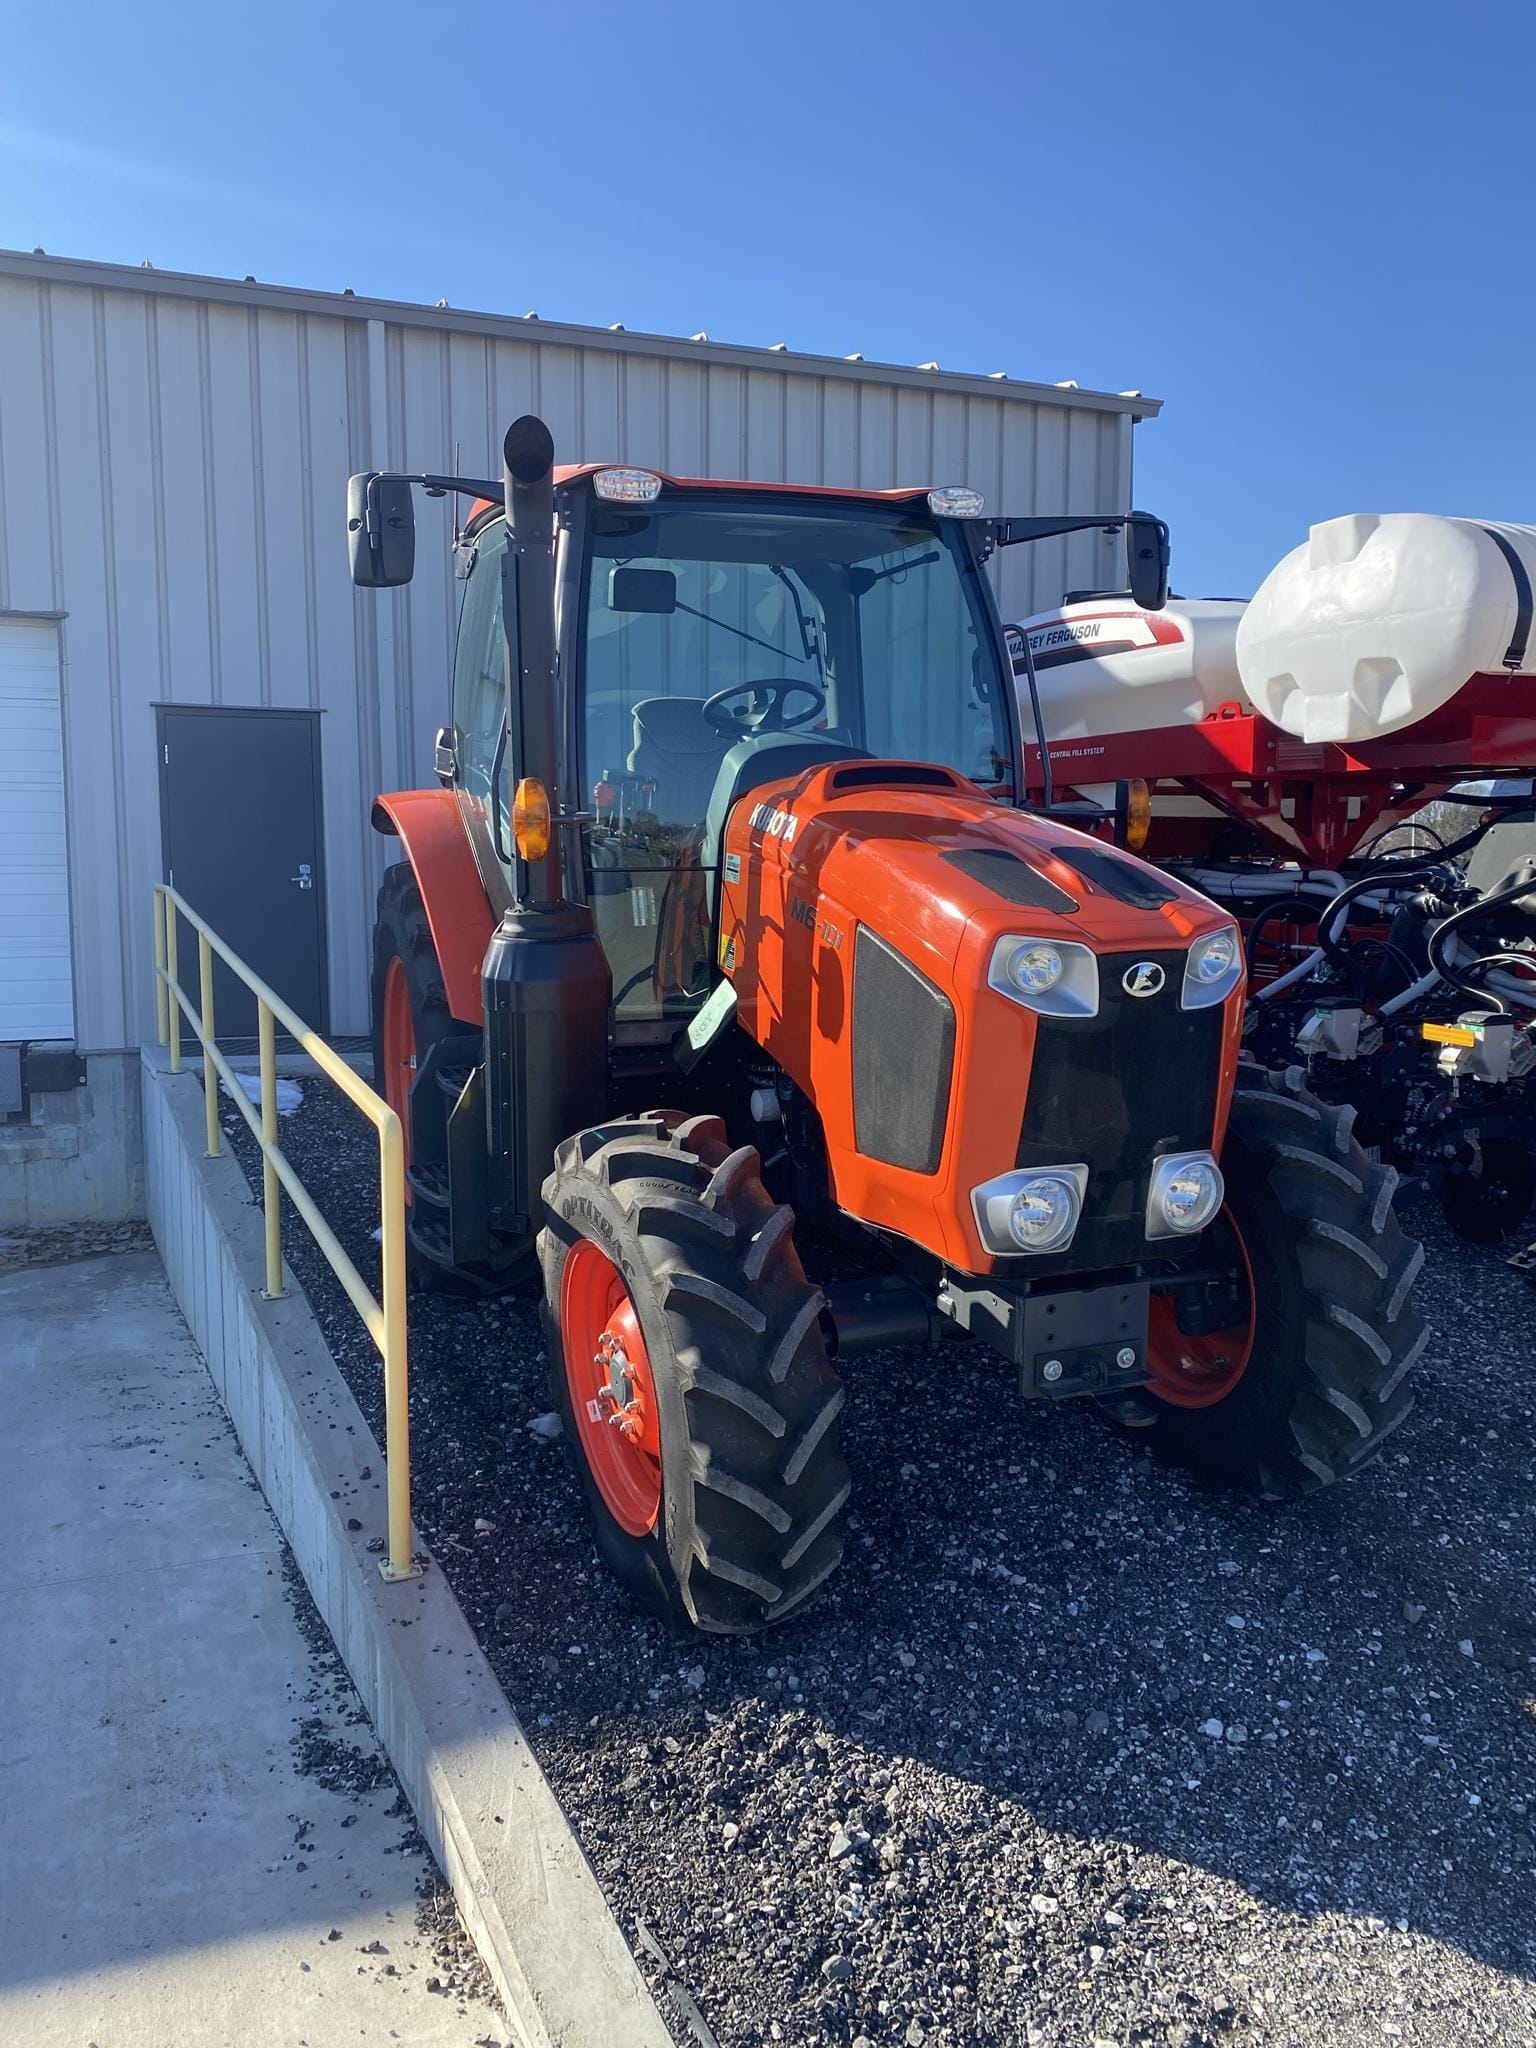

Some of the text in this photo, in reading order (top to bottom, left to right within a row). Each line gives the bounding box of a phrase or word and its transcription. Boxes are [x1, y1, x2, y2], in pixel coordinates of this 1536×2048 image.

[1009, 623, 1101, 655] MASEY FERGUSON
[1049, 750, 1071, 759] CENTRAL
[1083, 746, 1105, 756] SYSTEM
[748, 803, 799, 842] KUBOTA
